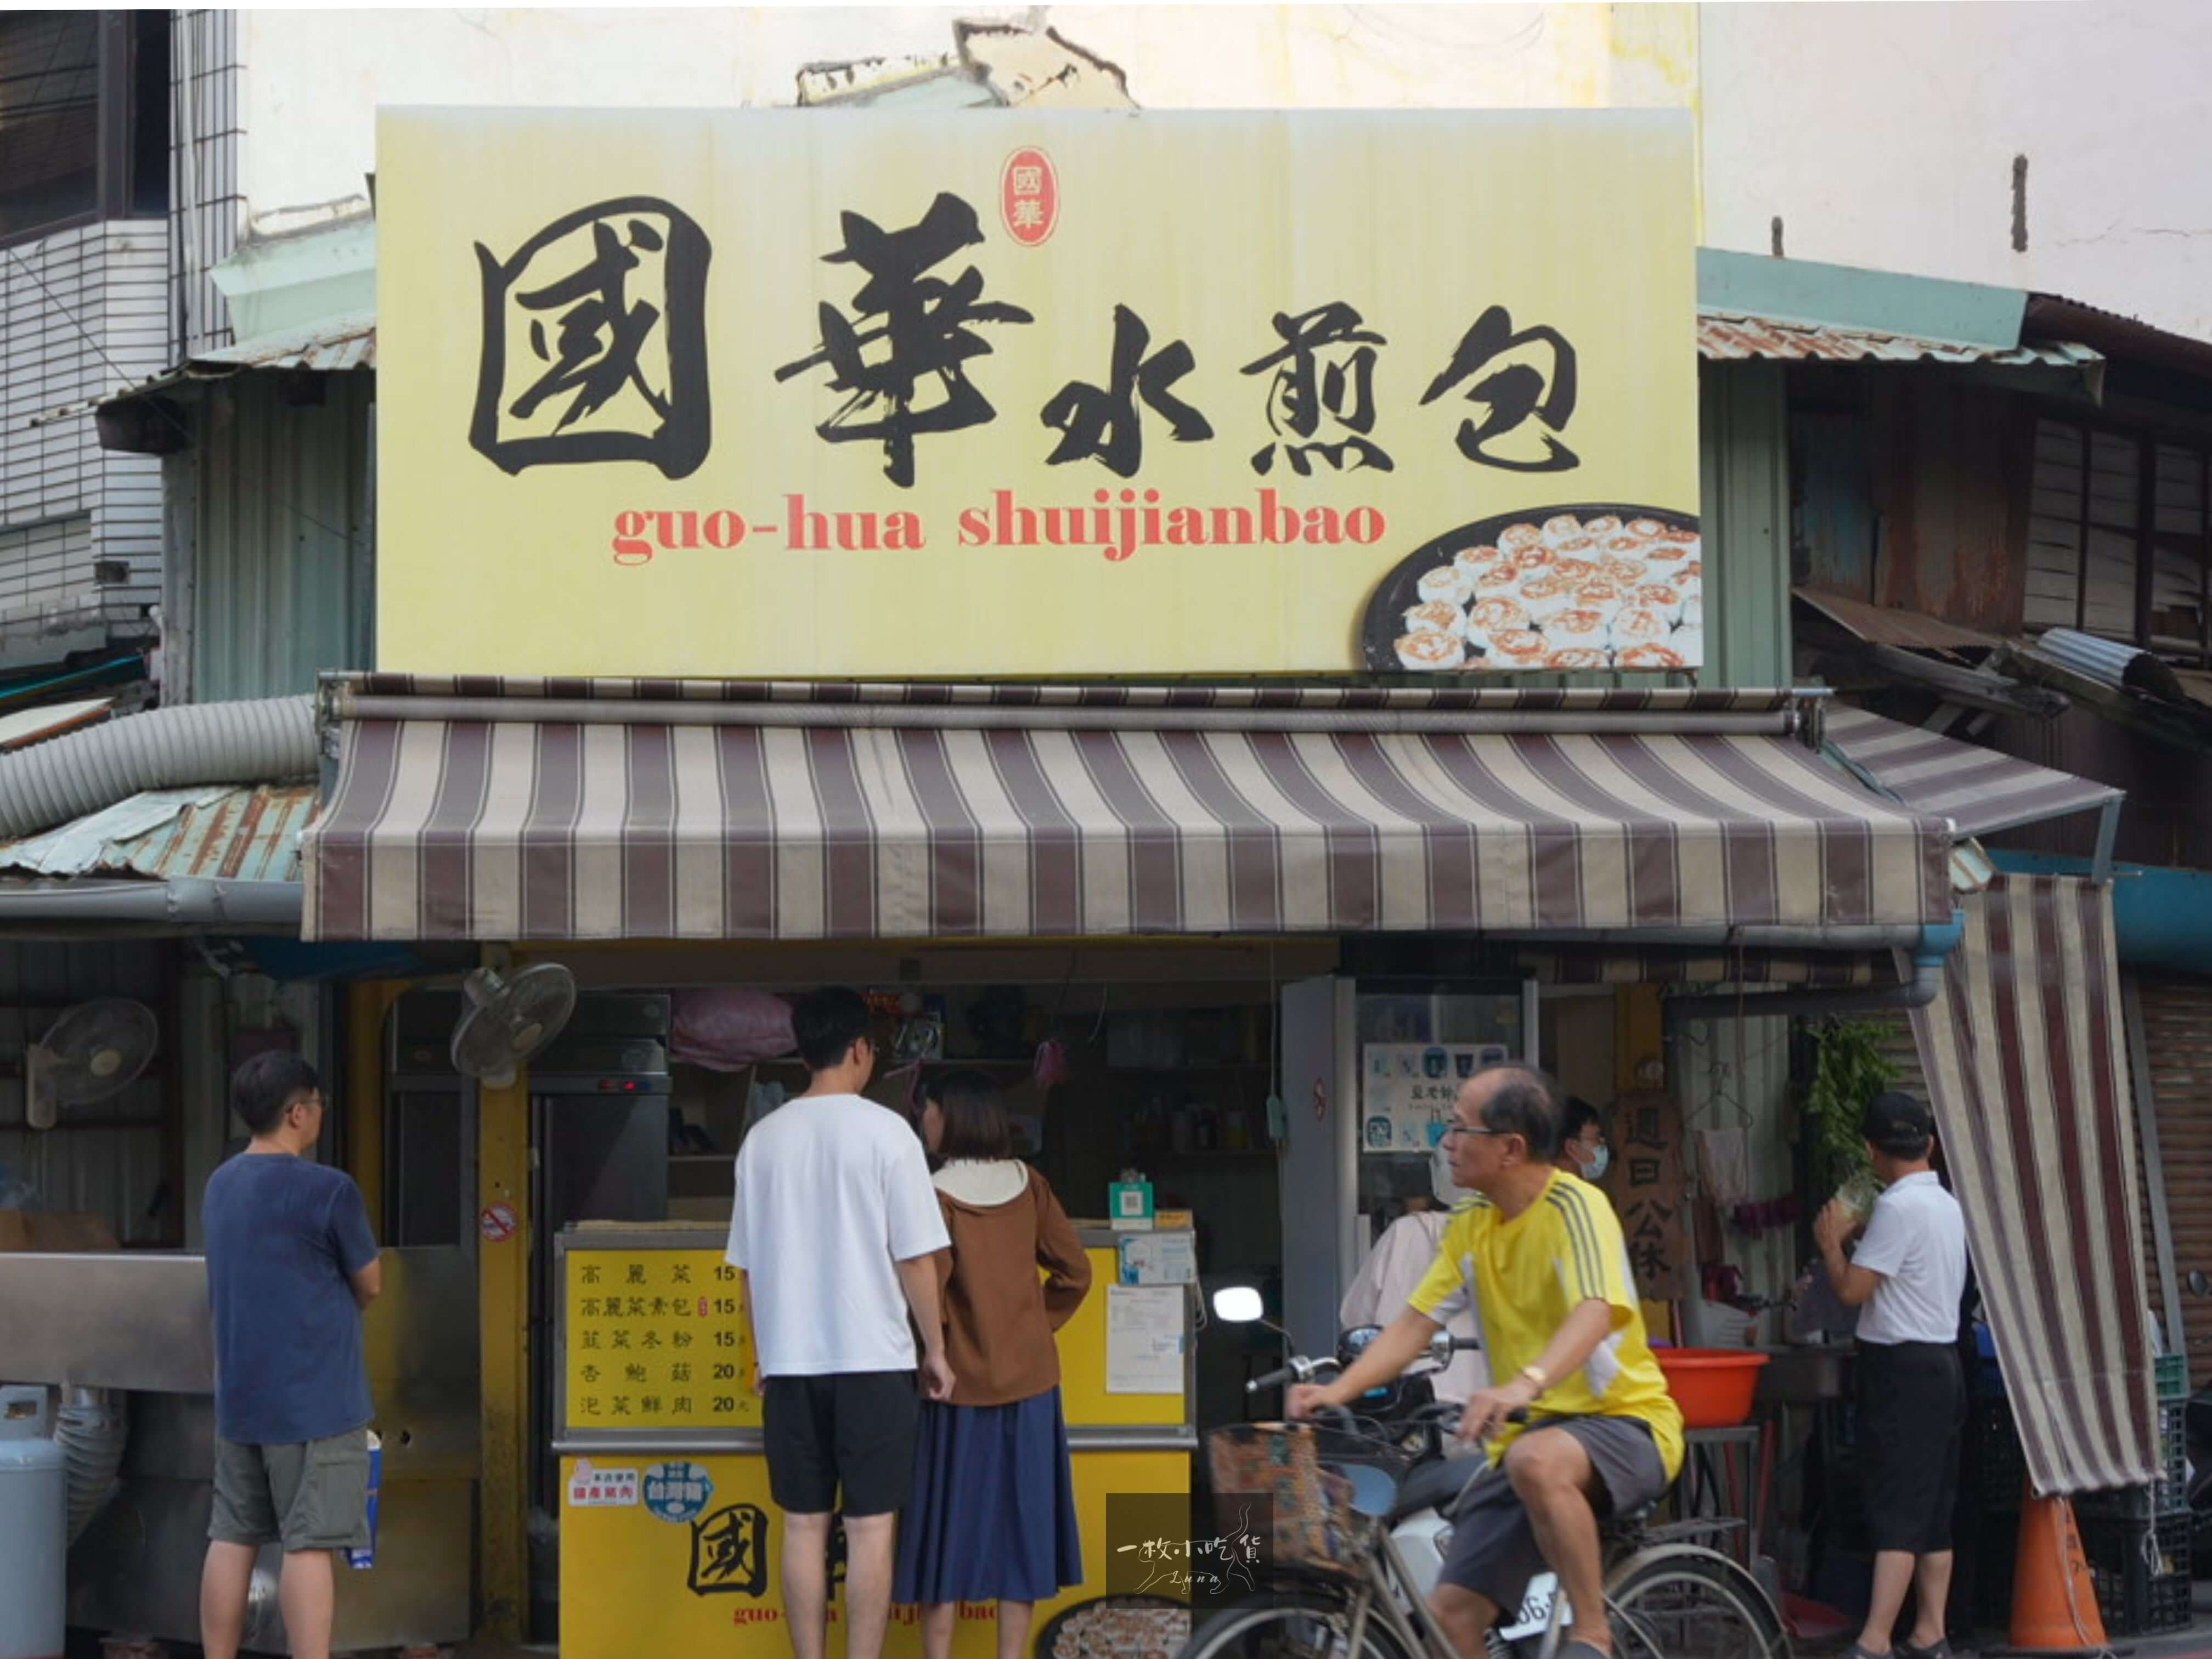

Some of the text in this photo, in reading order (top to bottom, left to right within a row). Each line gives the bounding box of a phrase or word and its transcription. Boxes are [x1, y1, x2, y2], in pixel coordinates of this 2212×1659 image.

[1012, 166, 1043, 229] 國華
[469, 193, 1579, 487] 國華水煎包
[612, 488, 1386, 565] guo-hua shuijianbao
[582, 1264, 736, 1284] 高麗菜 15
[580, 1296, 692, 1317] 高麗菜素包
[714, 1299, 736, 1314] 15
[714, 1331, 736, 1347] 15
[713, 1364, 735, 1379] 20
[580, 1396, 692, 1415] 泡菜鮮肉
[713, 1397, 735, 1413] 20
